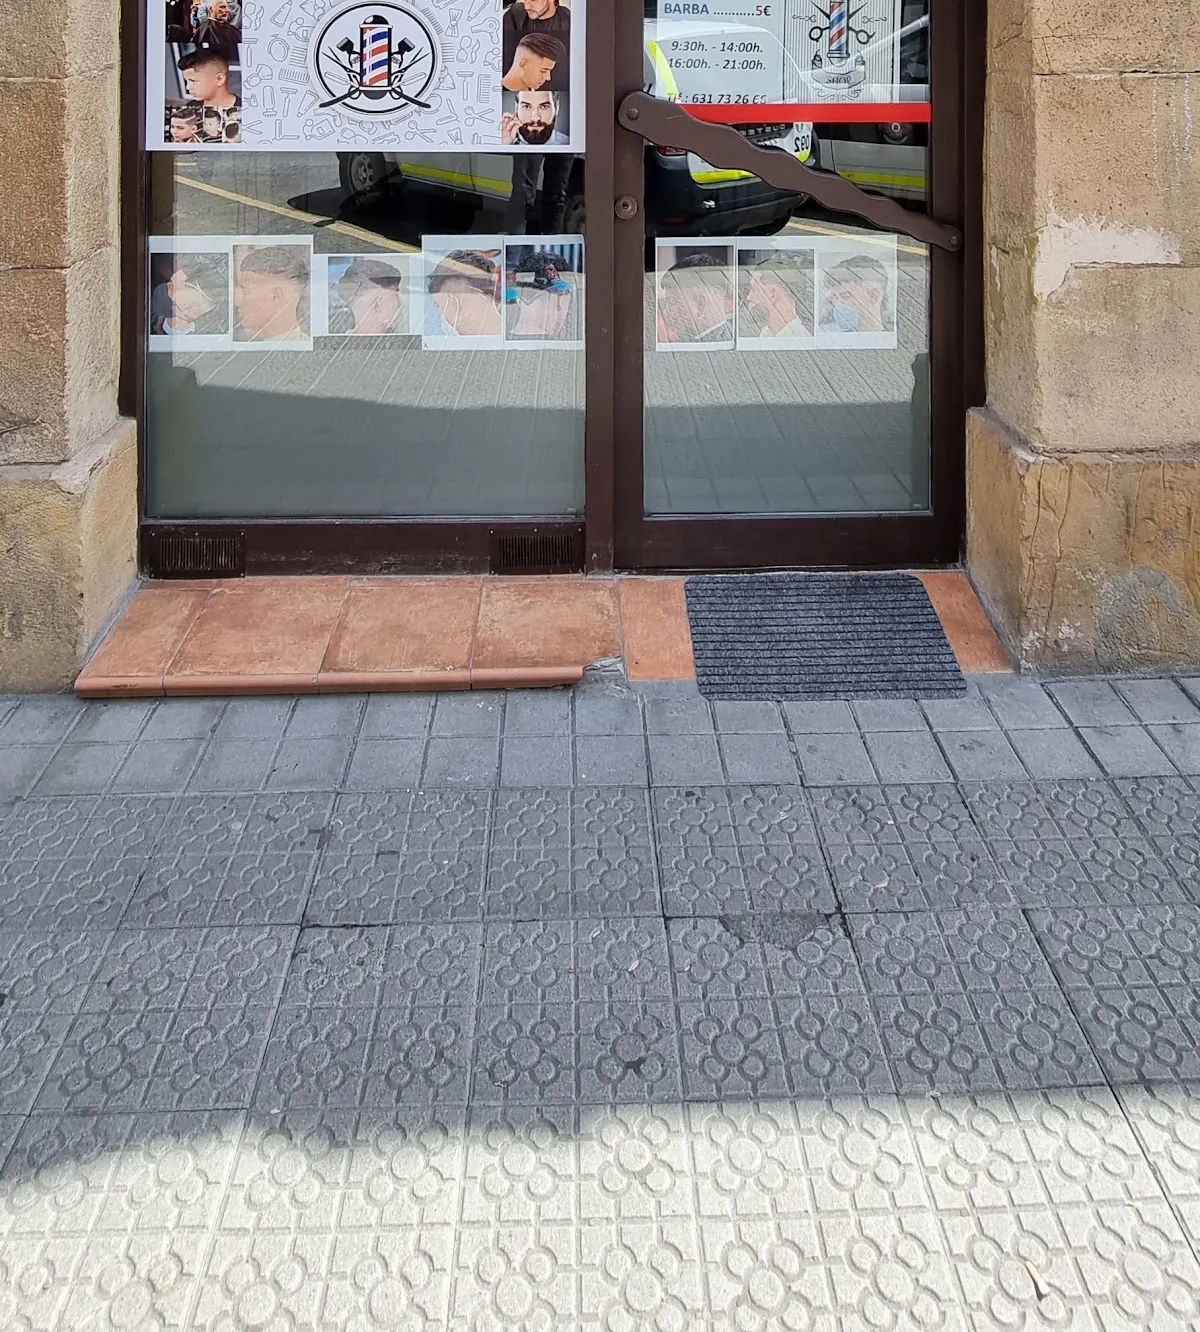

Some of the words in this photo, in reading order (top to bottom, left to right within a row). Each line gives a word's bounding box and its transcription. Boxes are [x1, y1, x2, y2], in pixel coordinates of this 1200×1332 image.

[664, 3, 709, 15] BARBA
[671, 41, 708, 52] 9:30h.
[720, 42, 763, 53] 14:00h.
[668, 58, 711, 69] 16:00h.
[722, 59, 766, 70] 21:00h.
[692, 93, 713, 104] 631
[717, 93, 731, 104] 73
[735, 94, 749, 104] 26
